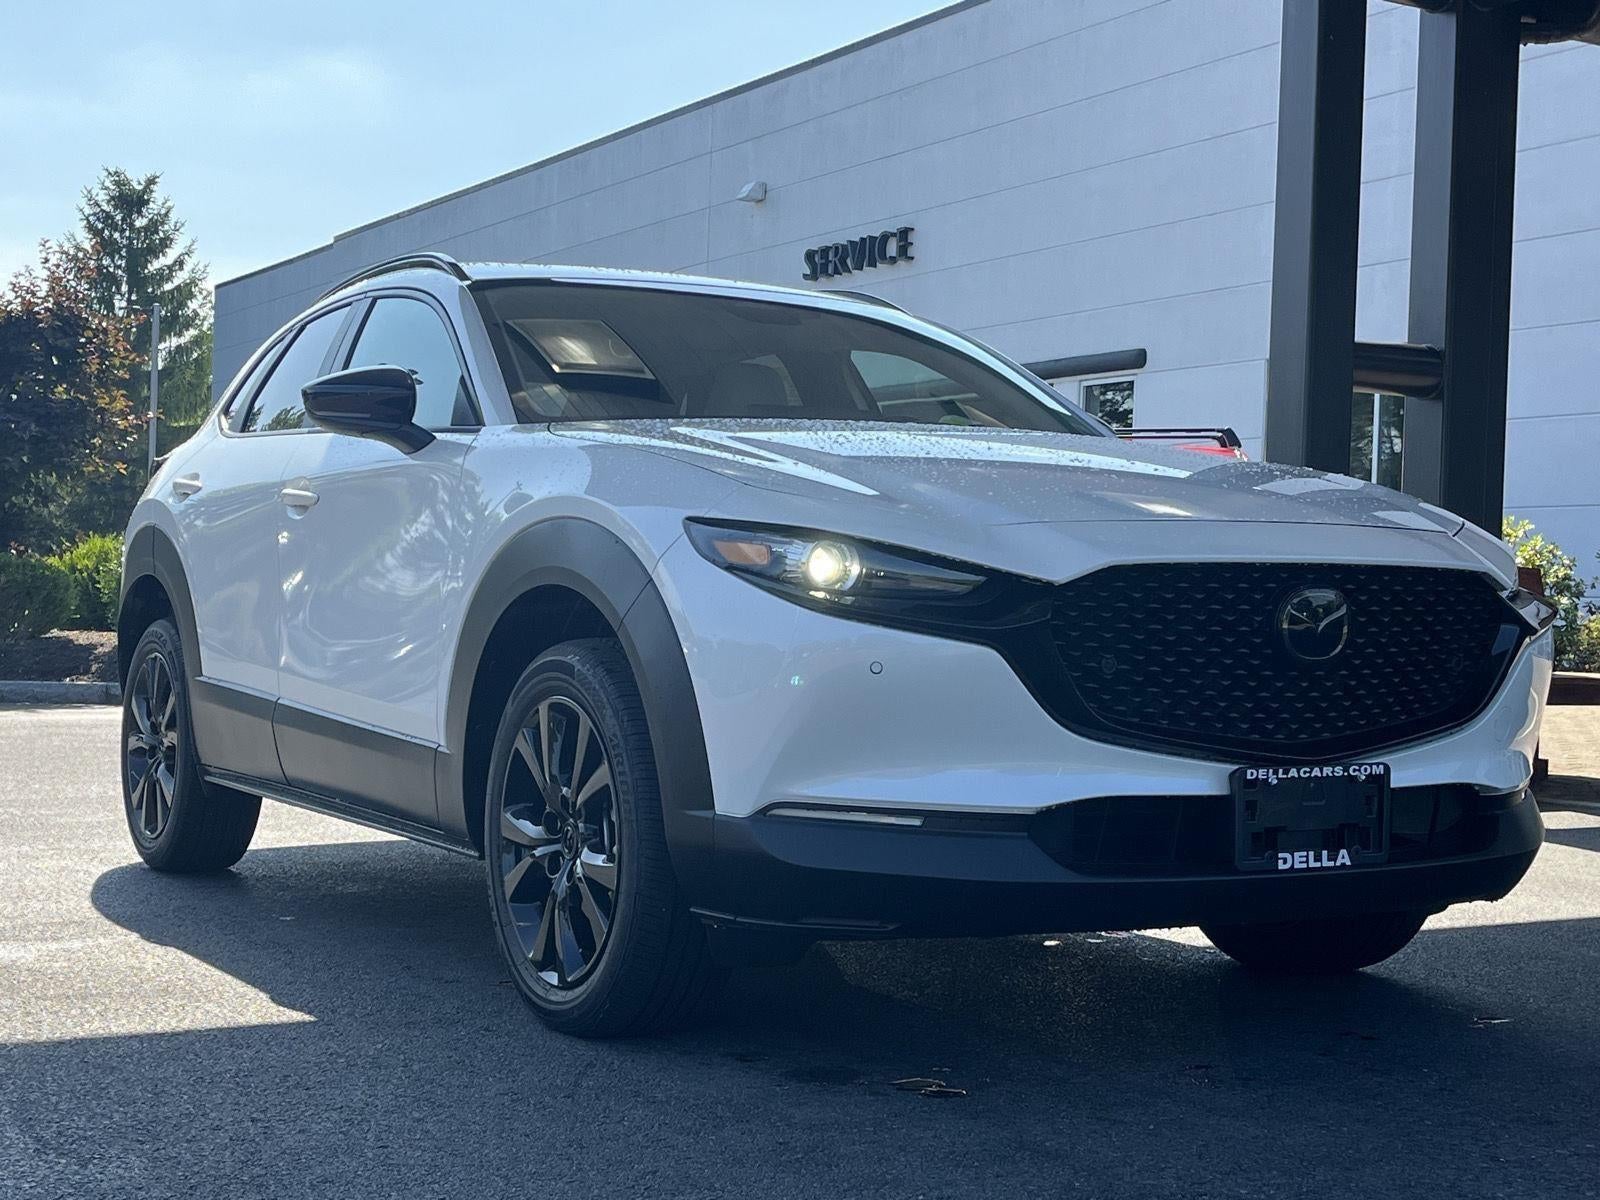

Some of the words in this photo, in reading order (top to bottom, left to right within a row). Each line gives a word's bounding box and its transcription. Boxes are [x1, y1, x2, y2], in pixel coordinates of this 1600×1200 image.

[802, 226, 915, 281] SERVICE
[1246, 764, 1385, 780] DELLACARS.COM
[1277, 849, 1352, 870] DELLA
